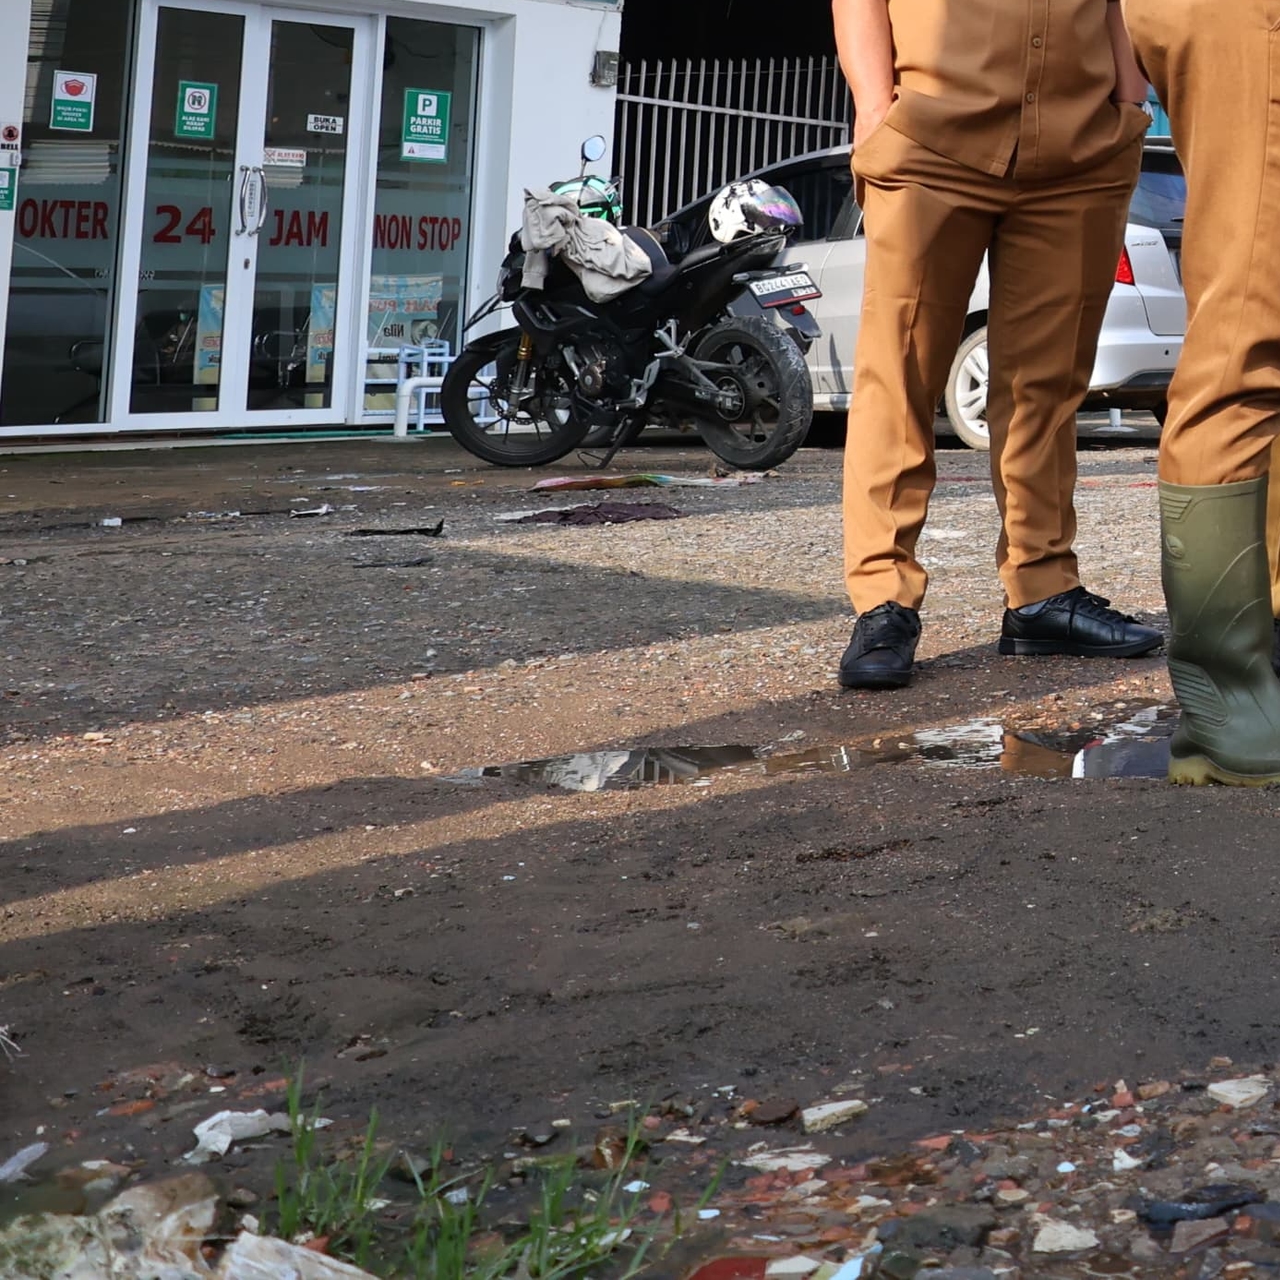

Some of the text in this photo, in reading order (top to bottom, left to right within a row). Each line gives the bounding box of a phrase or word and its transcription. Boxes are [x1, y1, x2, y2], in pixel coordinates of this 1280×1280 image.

[313, 116, 337, 124] BUKA
[410, 116, 443, 127] PARKIR
[313, 124, 337, 132] OPEN
[410, 124, 442, 135] GRATIS
[153, 205, 216, 244] 24
[269, 209, 329, 248] JAM
[373, 214, 412, 250] NON
[418, 215, 461, 251] STOP
